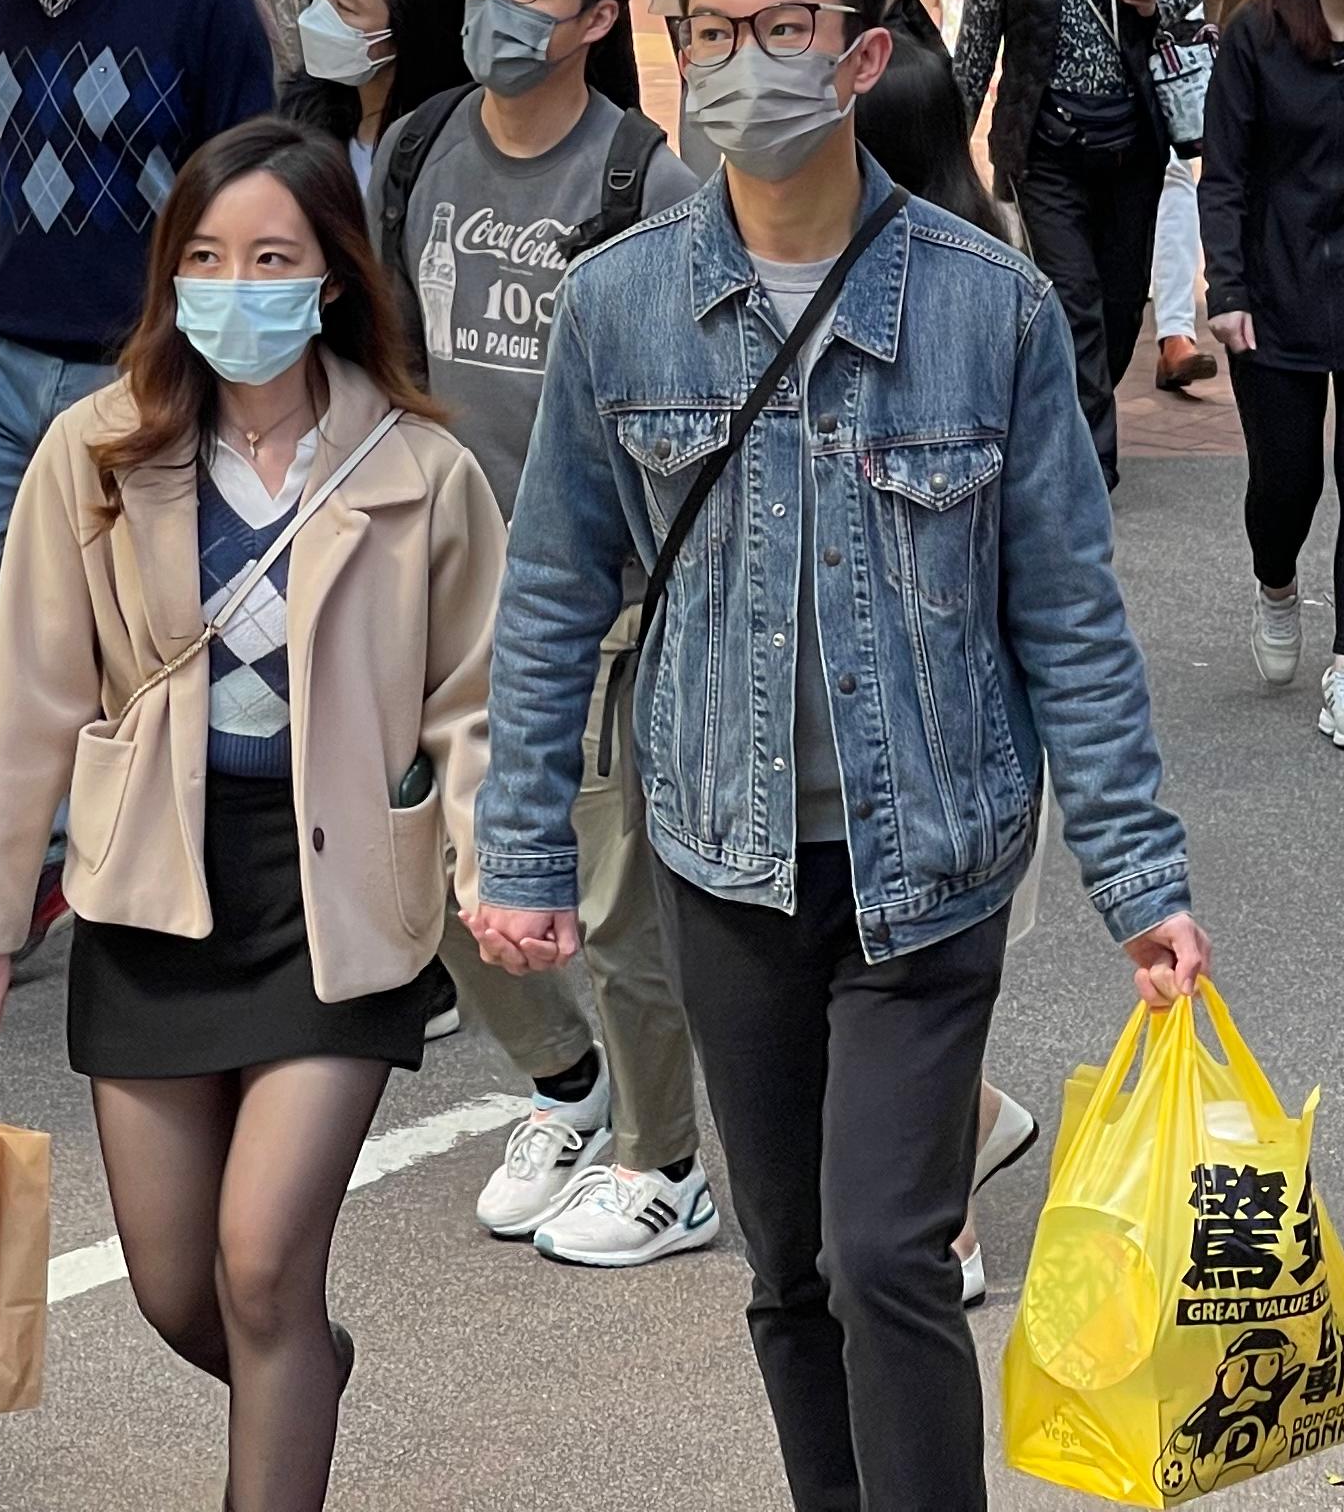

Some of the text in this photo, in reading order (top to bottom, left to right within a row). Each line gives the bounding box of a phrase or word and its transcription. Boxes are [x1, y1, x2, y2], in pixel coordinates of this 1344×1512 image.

[456, 327, 540, 361] NO PAGUE
[1186, 1300, 1250, 1322] GREAT
[1256, 1294, 1310, 1319] VALUE
